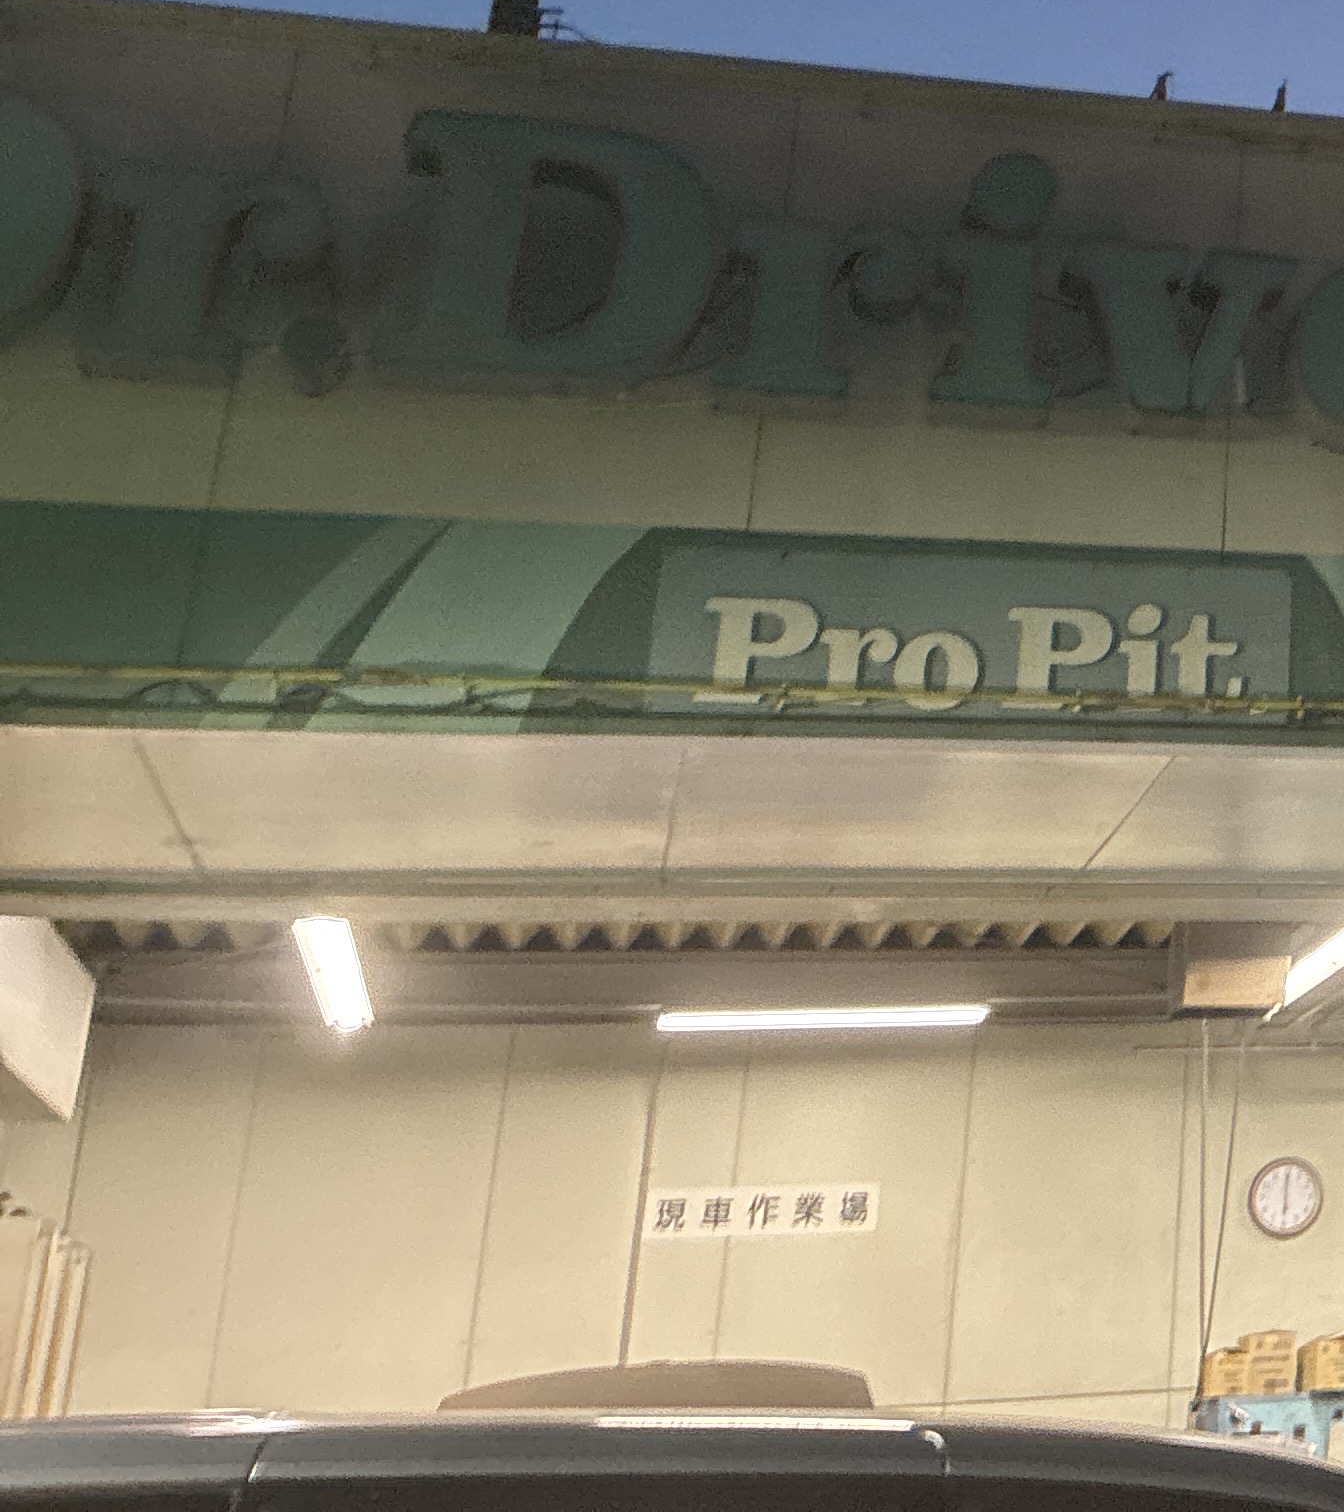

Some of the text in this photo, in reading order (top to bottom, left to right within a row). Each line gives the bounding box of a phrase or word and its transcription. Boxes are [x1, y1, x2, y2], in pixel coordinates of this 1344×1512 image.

[692, 596, 980, 711] Pro
[652, 1191, 869, 1232] 現車作業場
